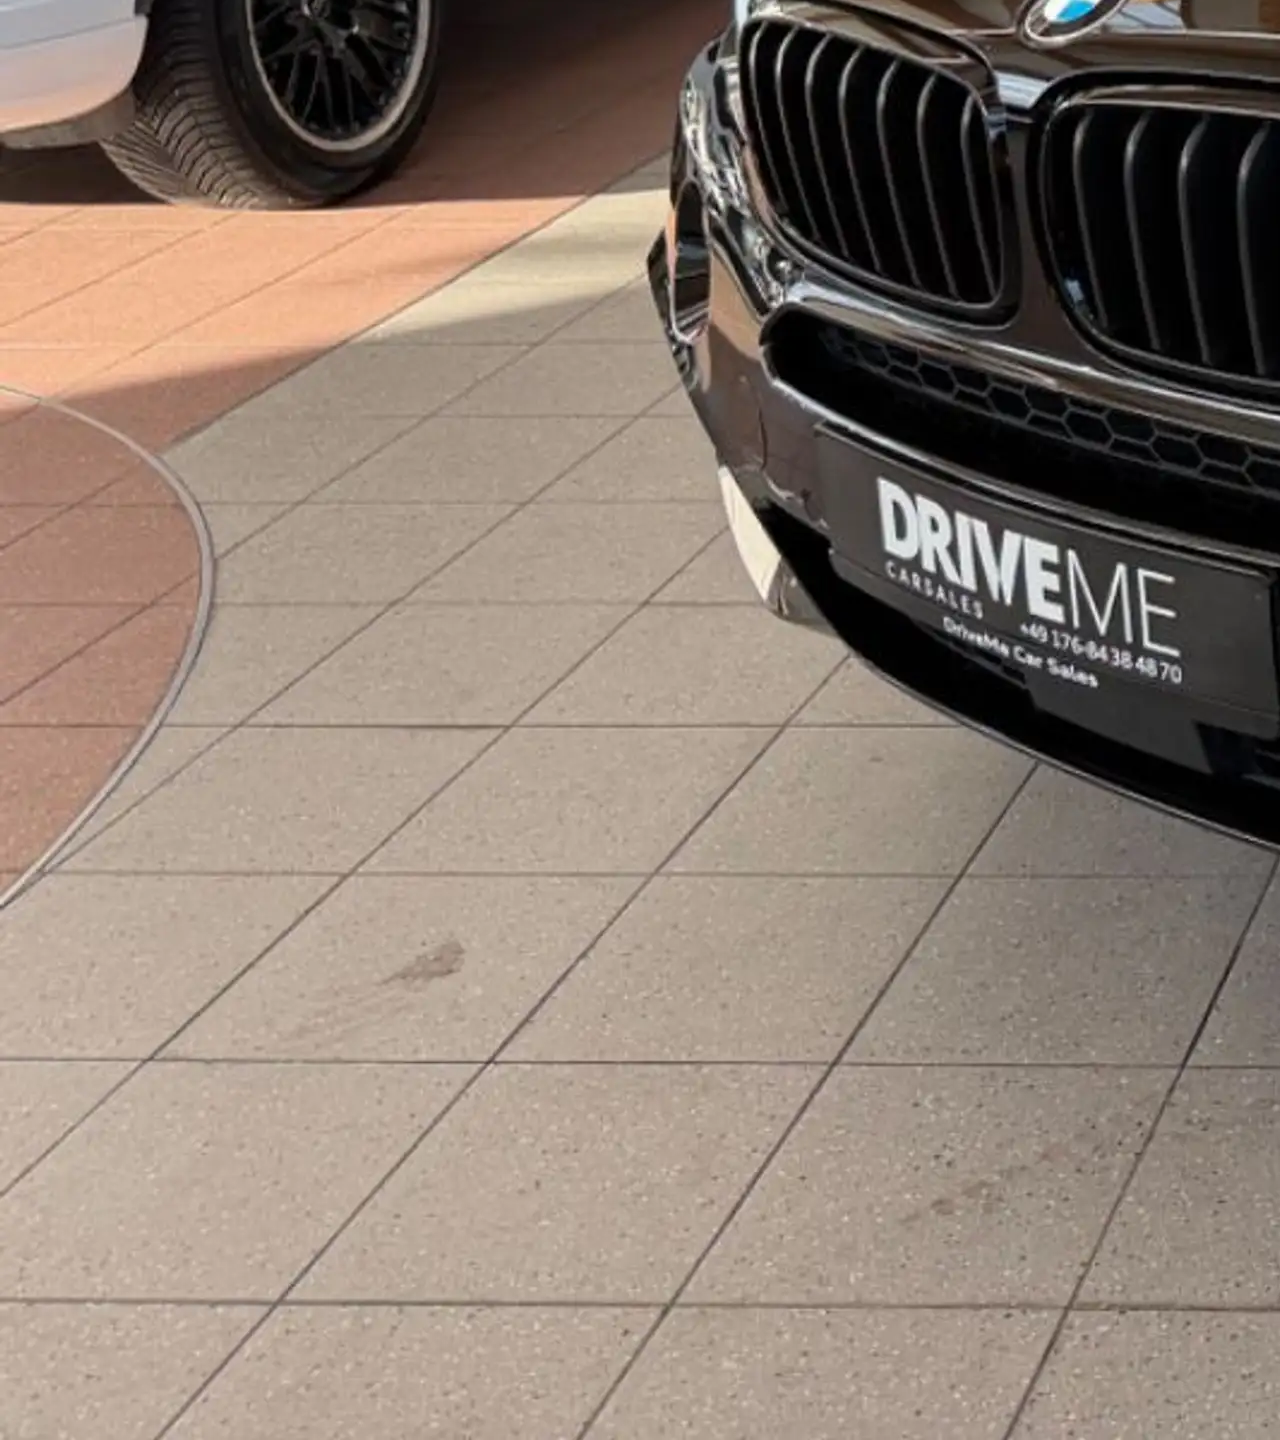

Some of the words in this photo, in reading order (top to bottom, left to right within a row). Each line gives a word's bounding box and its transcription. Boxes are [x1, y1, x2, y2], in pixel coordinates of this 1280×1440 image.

[876, 476, 1181, 657] DRIVEME
[885, 559, 984, 620] CARSALES
[1013, 645, 1043, 668] Car
[1047, 657, 1099, 688] Sales
